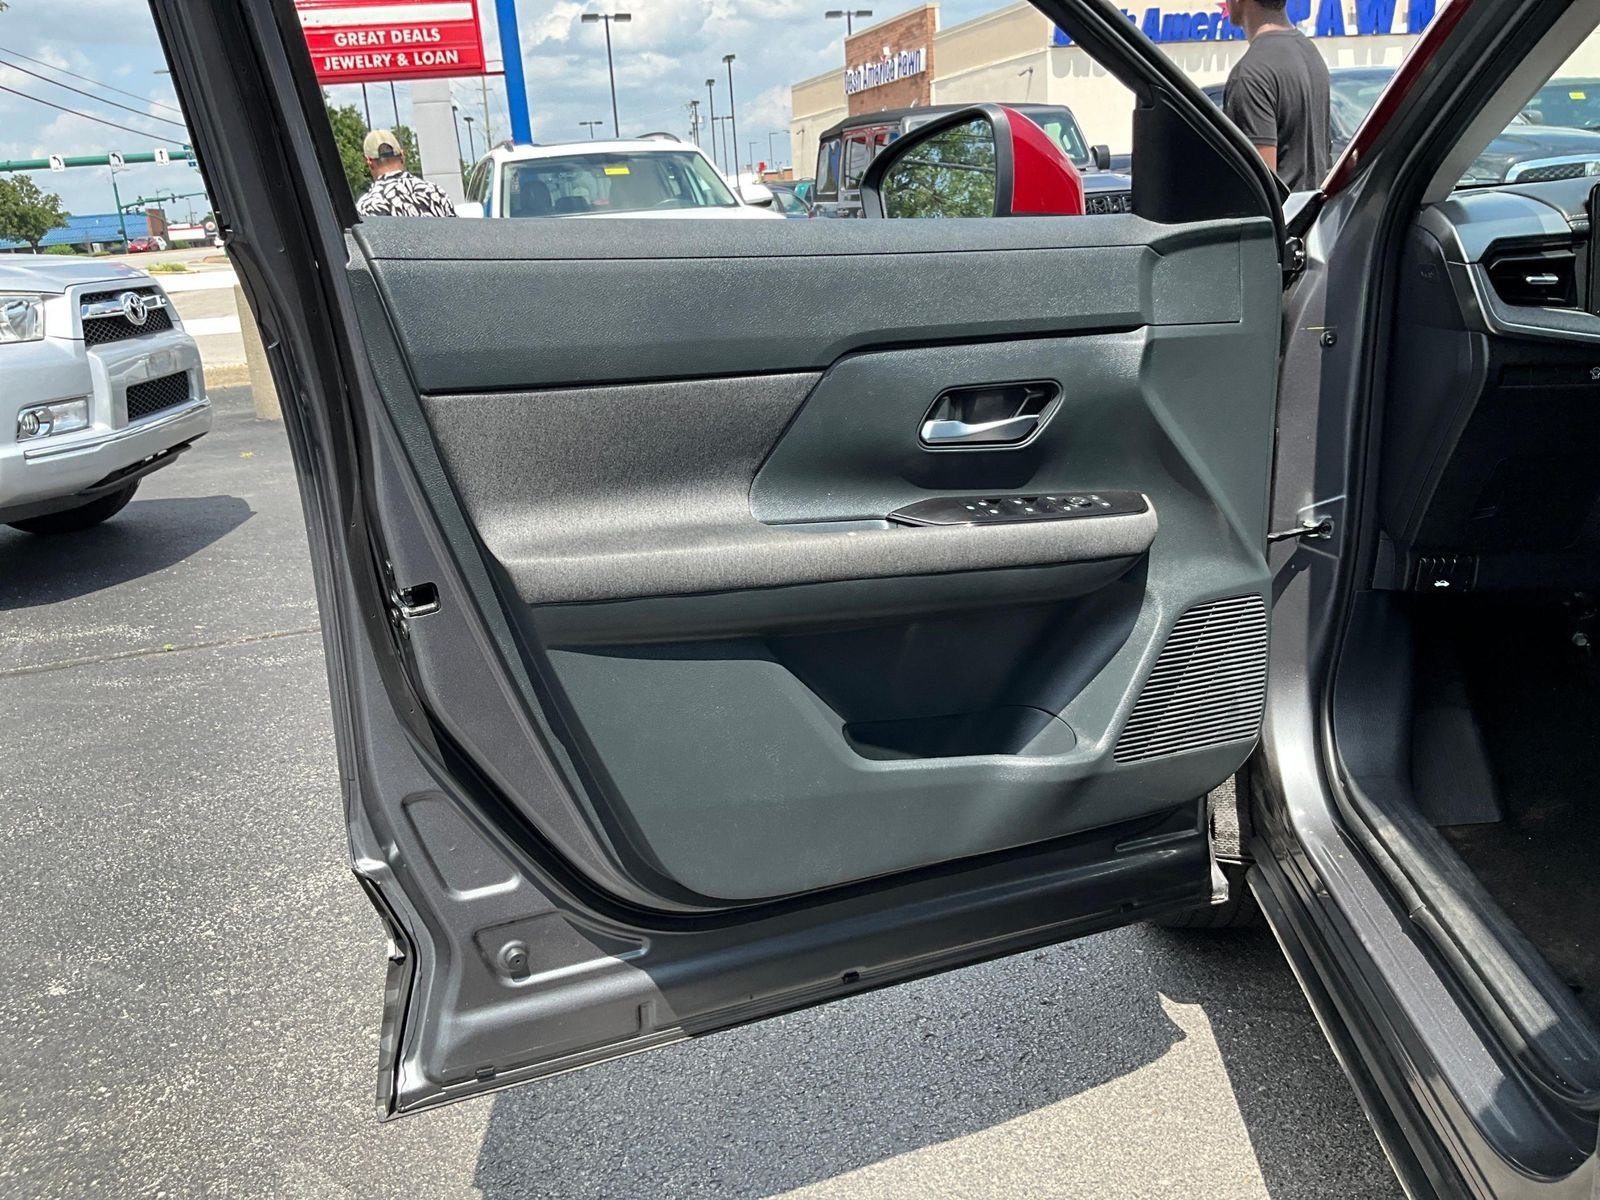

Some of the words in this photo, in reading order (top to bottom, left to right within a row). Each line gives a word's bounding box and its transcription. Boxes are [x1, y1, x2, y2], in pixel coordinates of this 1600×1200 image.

[333, 31, 386, 47] GREAT
[390, 28, 440, 42] DEALS
[1141, 8, 1248, 41] Ameri
[324, 53, 391, 71] JEWELRY
[396, 52, 409, 66] &
[414, 50, 458, 66] LOAN
[863, 59, 896, 90] America
[897, 48, 926, 77] Pawn
